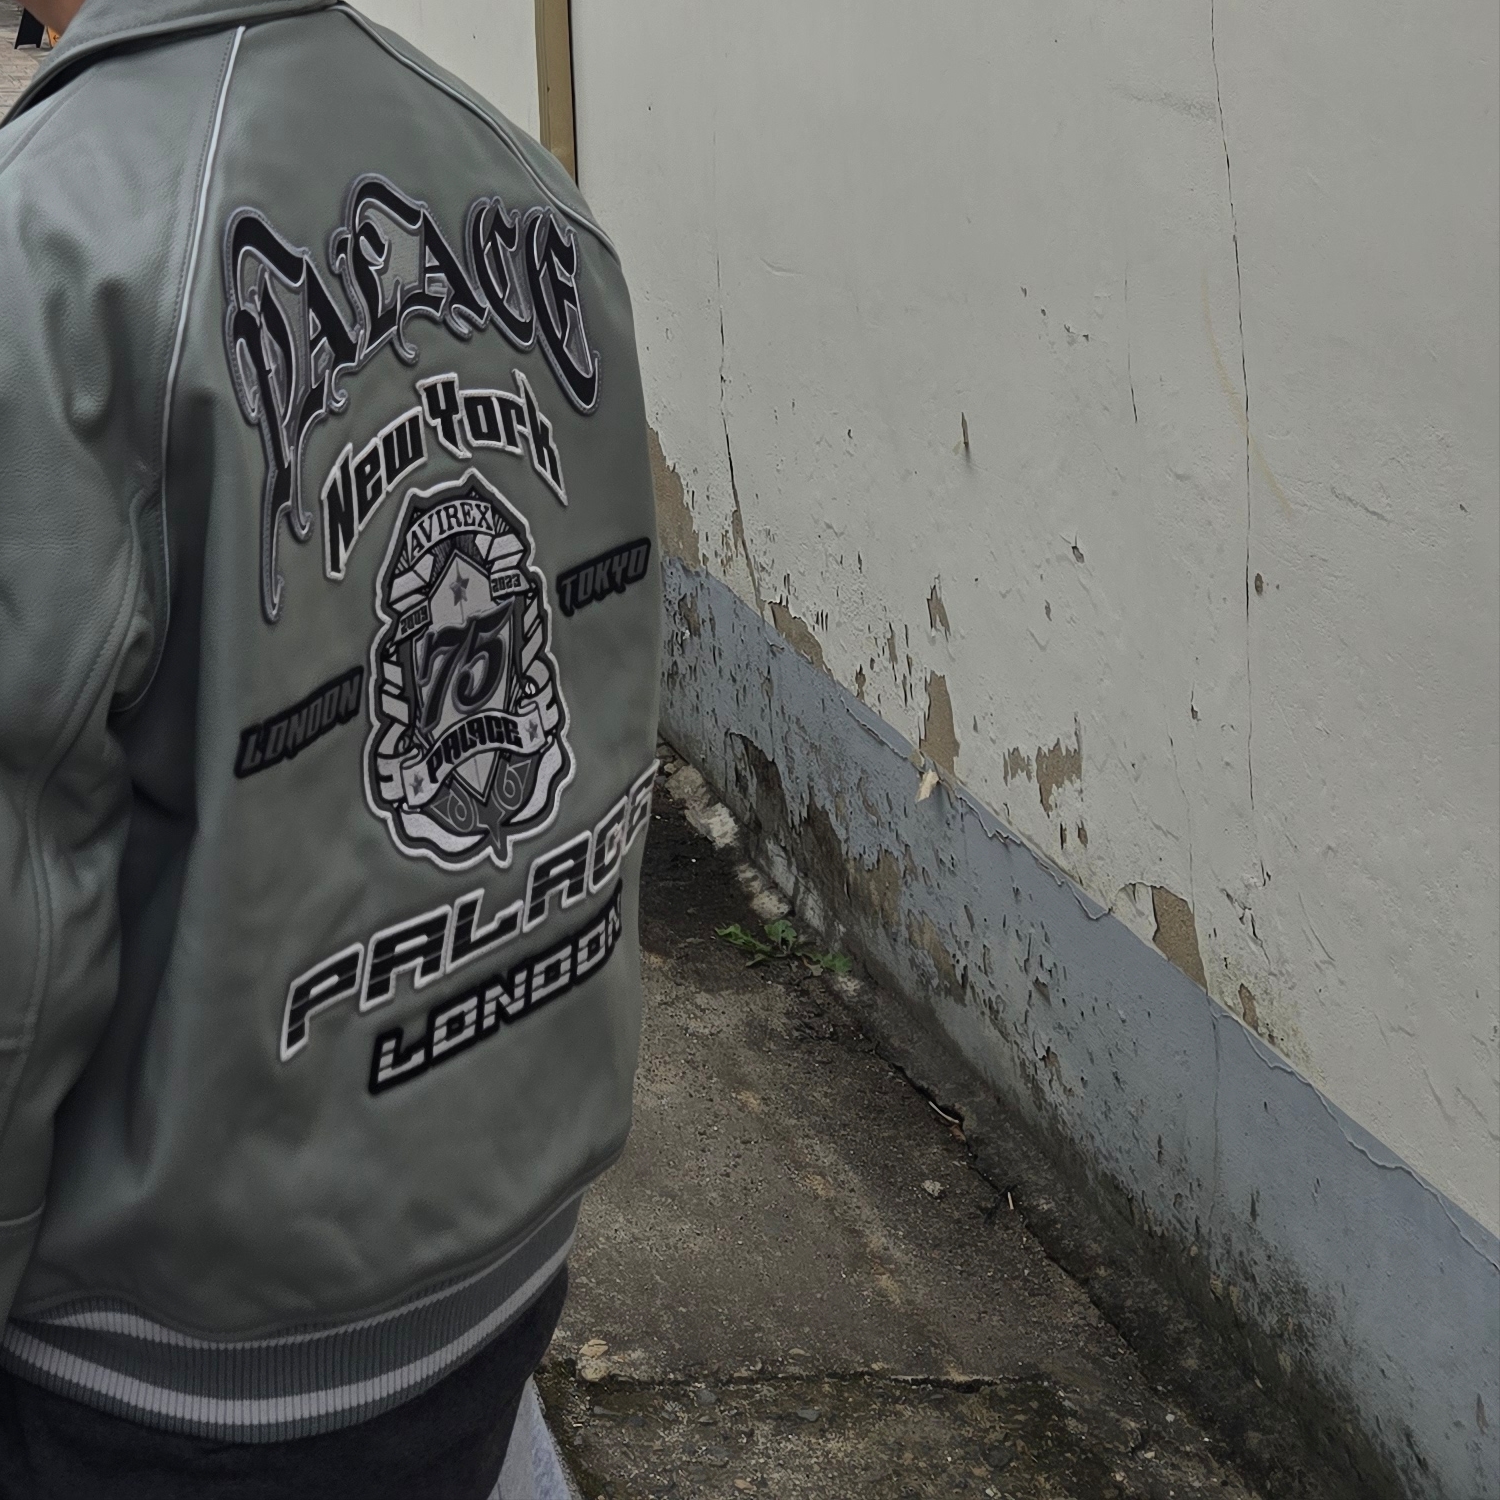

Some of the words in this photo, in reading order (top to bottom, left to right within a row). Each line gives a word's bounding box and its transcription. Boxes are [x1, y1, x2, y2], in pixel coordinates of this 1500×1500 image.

[224, 173, 599, 623] PALACE
[322, 407, 428, 579] New
[417, 370, 568, 505] York
[410, 502, 496, 560] AVIREX
[561, 544, 648, 611] TOKYO
[242, 675, 360, 771] LONDON
[418, 601, 514, 734] 75
[426, 713, 523, 784] PALACE
[280, 759, 660, 1061] PALACE
[376, 893, 623, 1084] LONDON
